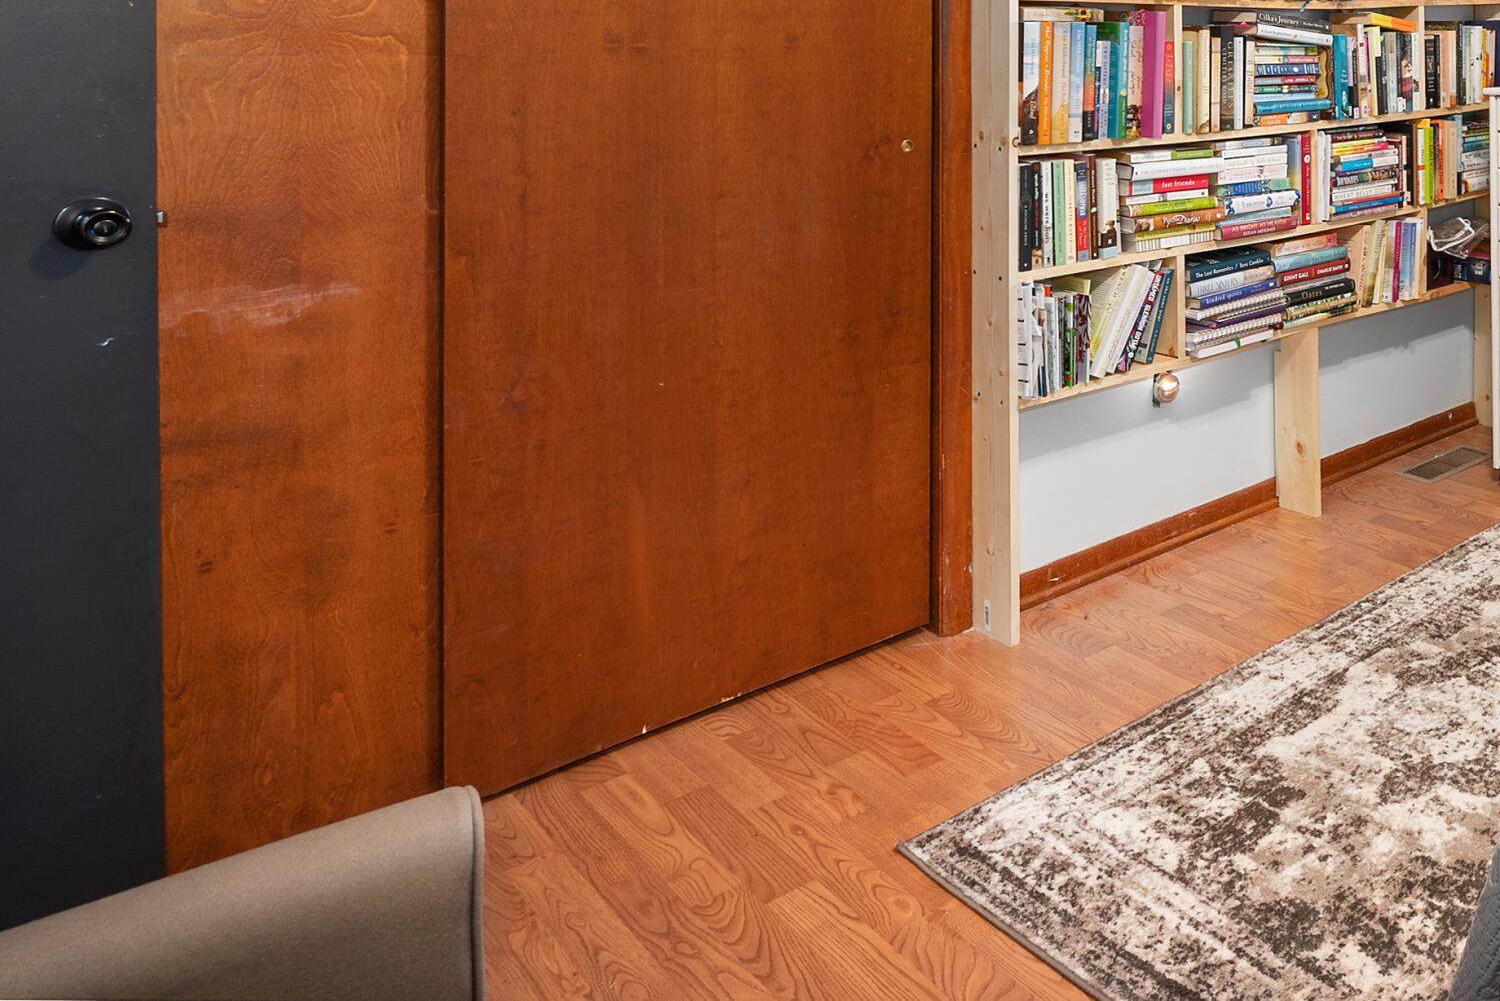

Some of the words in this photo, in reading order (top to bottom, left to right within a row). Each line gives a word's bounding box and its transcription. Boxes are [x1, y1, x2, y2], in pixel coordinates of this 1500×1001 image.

[1259, 12, 1277, 23] Cilka's
[1278, 16, 1299, 27] Journey
[1029, 101, 1037, 119] Island
[1173, 179, 1195, 187] friends
[1148, 274, 1161, 302] UNTAMED
